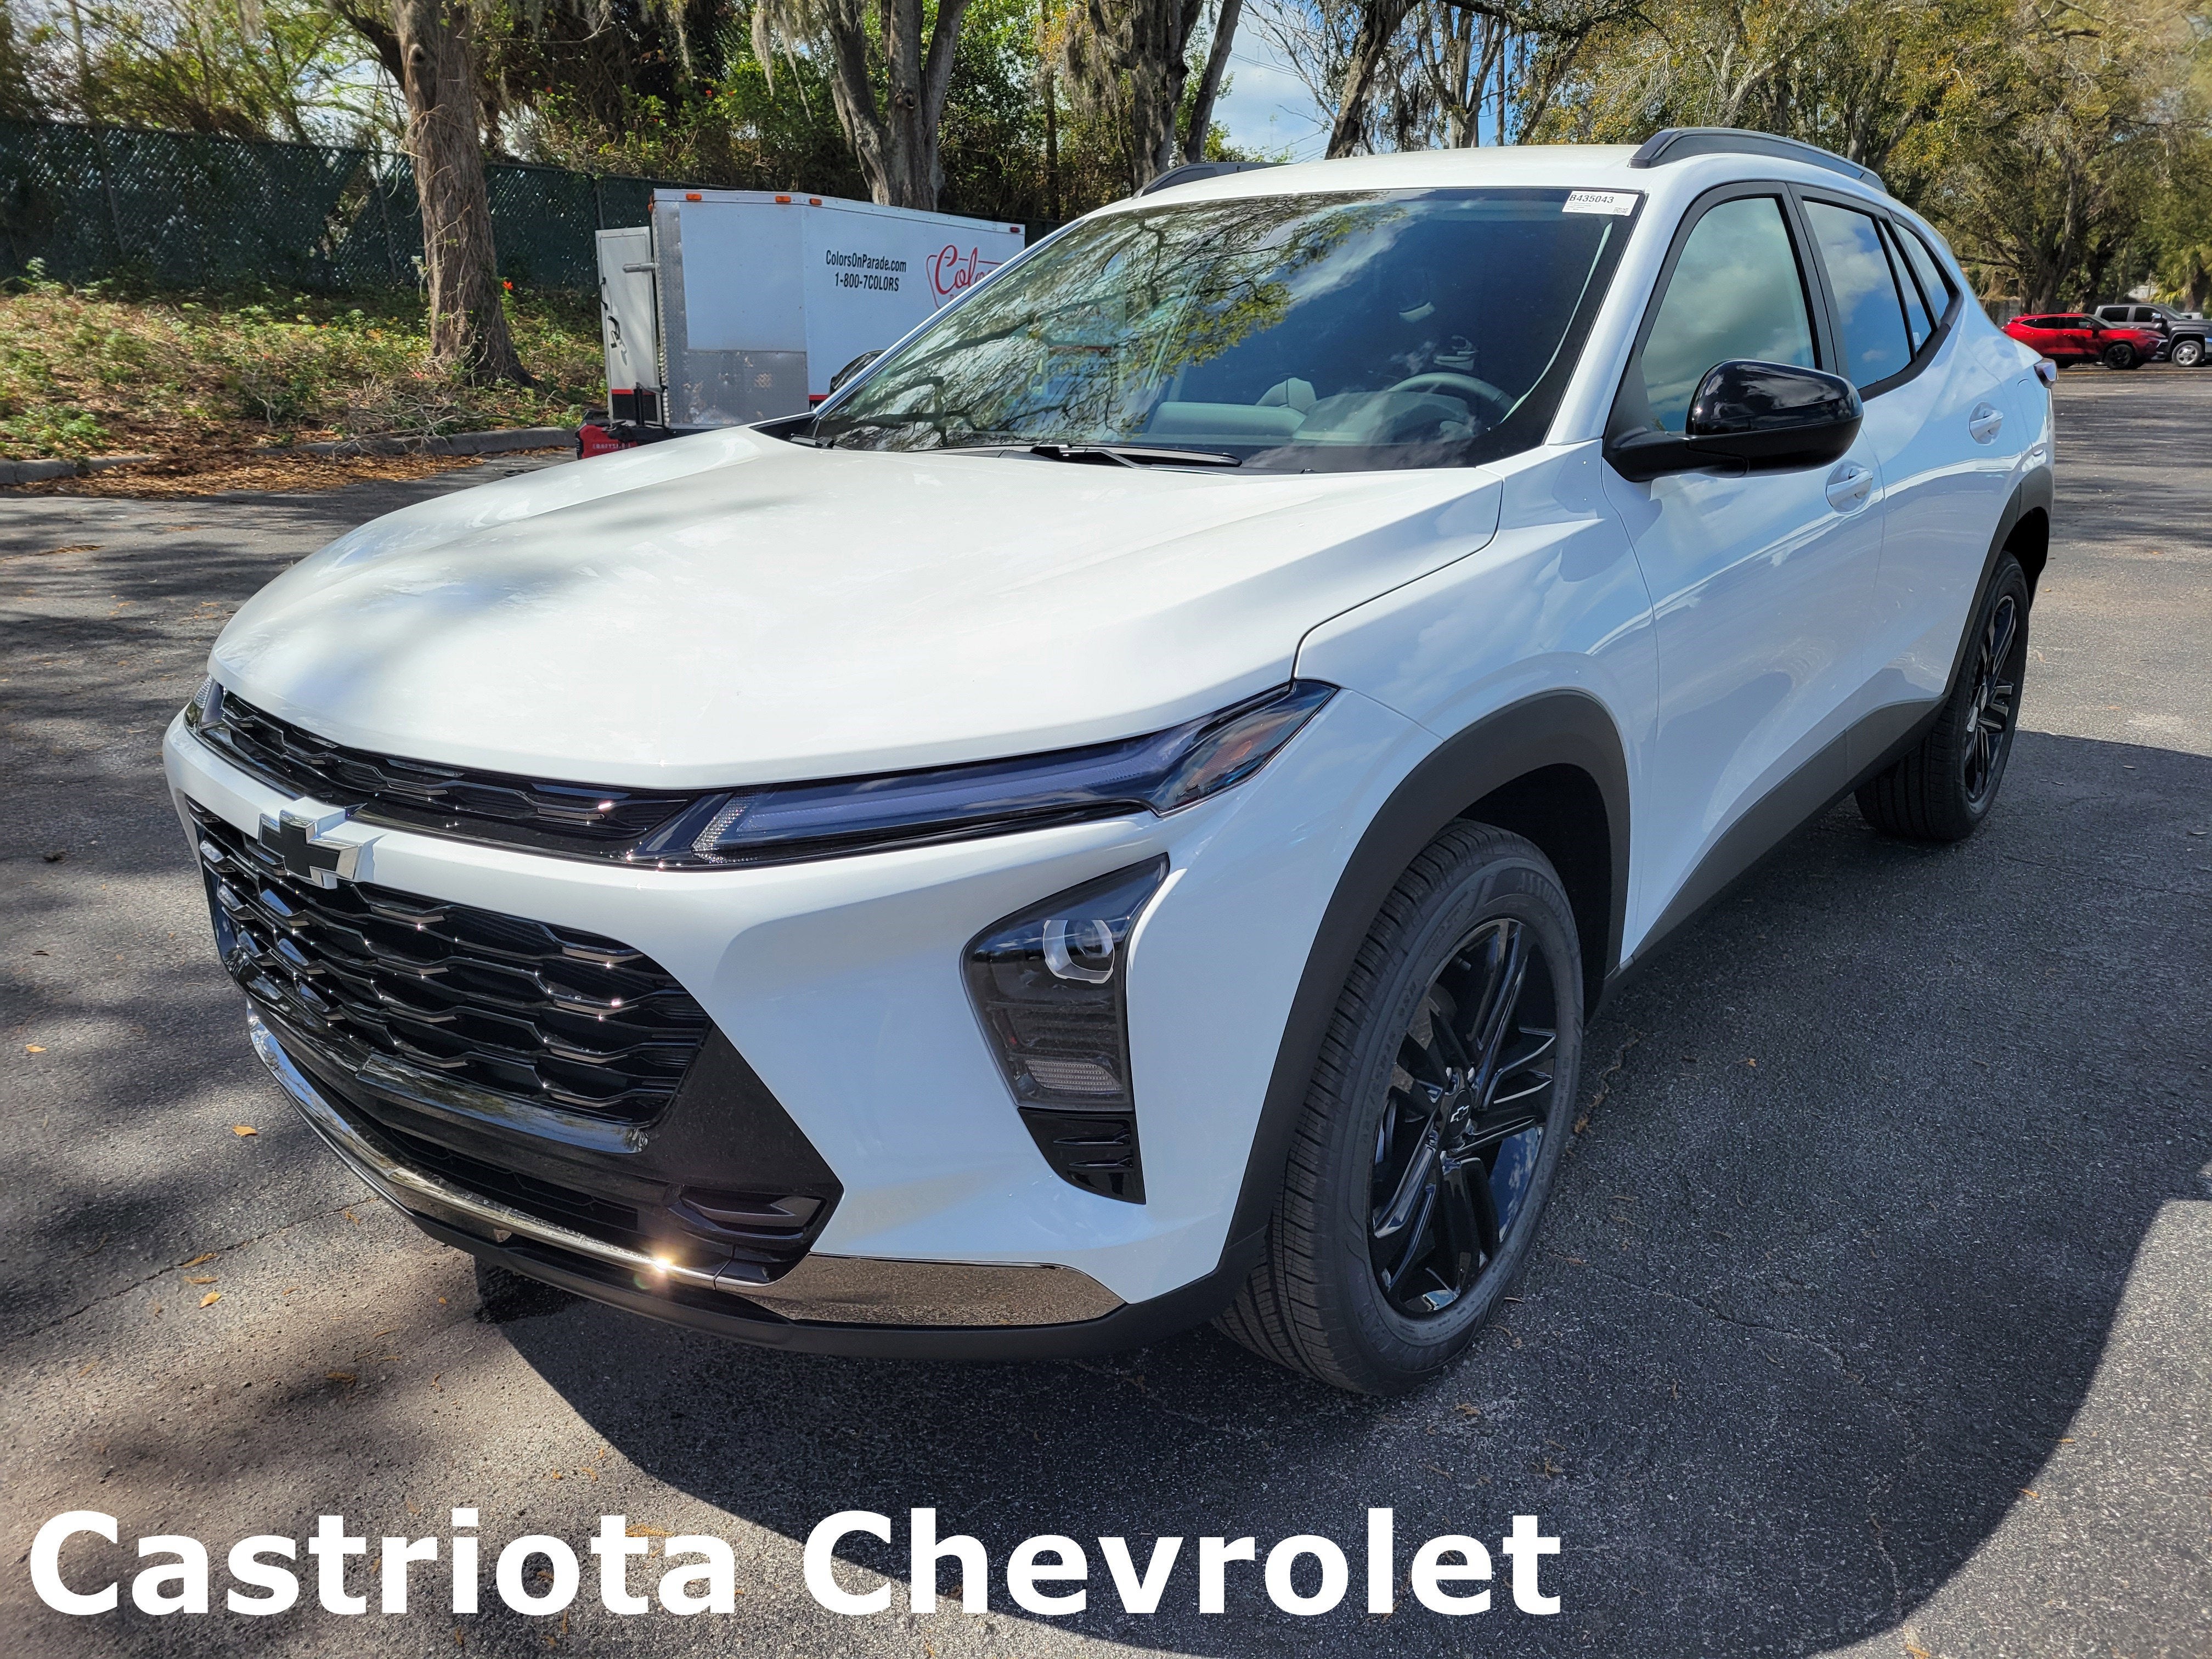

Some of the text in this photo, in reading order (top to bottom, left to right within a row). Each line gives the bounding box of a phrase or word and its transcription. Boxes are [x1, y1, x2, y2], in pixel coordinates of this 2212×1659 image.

[1569, 194, 1615, 204] B435043
[826, 250, 906, 273] ColorsOnParade.com
[835, 272, 899, 292] 1-800-7COLORS
